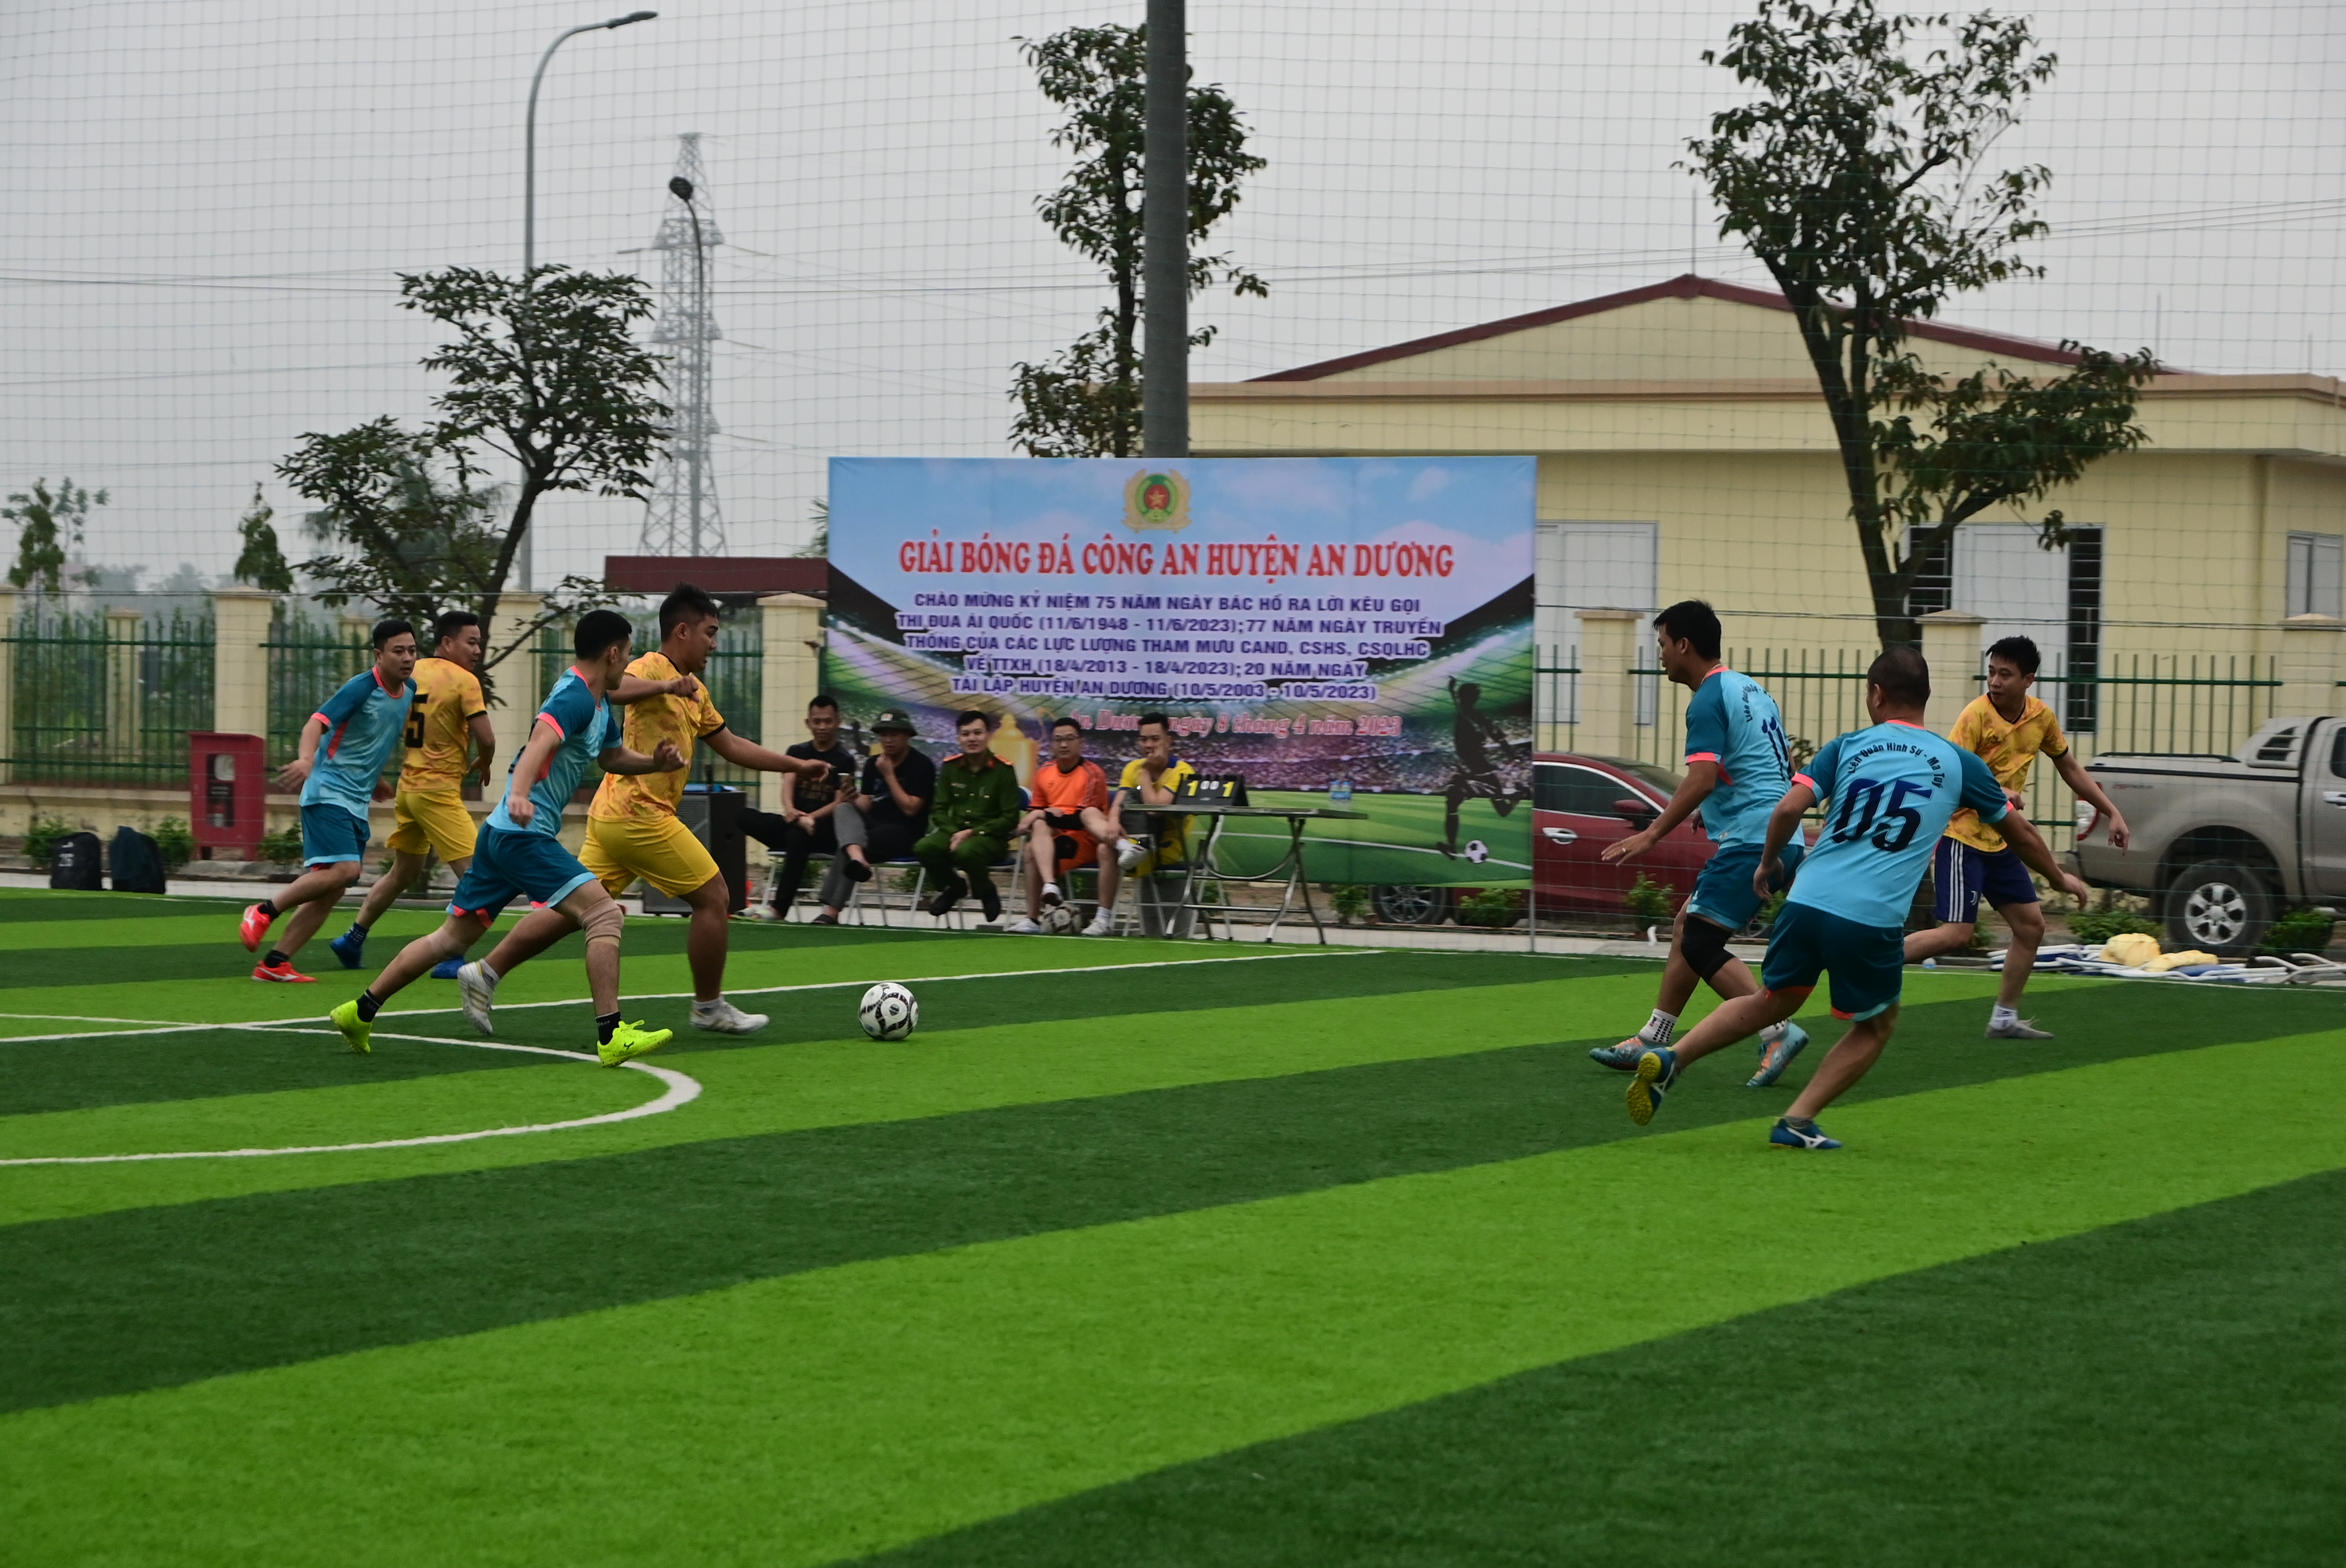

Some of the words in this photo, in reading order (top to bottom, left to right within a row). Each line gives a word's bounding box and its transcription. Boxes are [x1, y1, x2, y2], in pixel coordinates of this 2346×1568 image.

[900, 528, 955, 573] GIẢI
[960, 532, 1031, 574] BÓNG
[1038, 533, 1076, 574] ĐÁ
[1082, 533, 1155, 574] CÔNG
[1160, 542, 1200, 576] AN
[1206, 533, 1300, 584] HUYỆN
[1306, 543, 1348, 576] AN
[1353, 541, 1455, 577] DƯƠNG
[914, 590, 959, 607] CHÀO
[964, 590, 1014, 608] MỪNG
[1046, 593, 1090, 611] NIỆM
[1095, 596, 1116, 609] 75
[1121, 594, 1161, 610] NĂM
[1167, 594, 1213, 610] NGÀY
[1219, 595, 1253, 611] BÁC
[1289, 598, 1312, 612] RA
[1350, 596, 1384, 612] KÊU
[1391, 599, 1421, 615] GỌI
[898, 614, 922, 628] THI
[928, 615, 961, 629] ĐUA
[967, 612, 983, 628] ÁI
[988, 610, 1034, 629] QUỐC
[1039, 617, 1128, 631] (11/6/1948
[1273, 616, 1313, 633] NĂM
[1320, 617, 1367, 633] NGÀY
[967, 630, 999, 649] CỦA
[1006, 633, 1038, 650] CÁC
[1044, 637, 1075, 653] LỰC
[1081, 637, 1136, 654] LƯỢNG
[1143, 639, 1189, 653] THAM
[1196, 638, 1234, 653] MƯU
[1358, 642, 1428, 657] CSQLHC
[992, 657, 1032, 671] TTXH
[1038, 660, 1127, 675] (18/4/2013
[1271, 661, 1311, 676] NĂM
[1317, 661, 1365, 677] NGÀY
[952, 674, 977, 691] TÁI
[983, 675, 1014, 695] LẬP
[1020, 677, 1074, 696] HUYỆN
[1081, 681, 1103, 694] AN
[1110, 680, 1167, 695] DƯƠNG
[1174, 682, 1264, 698] (10/5/2003
[1284, 684, 1376, 700] 10/5/2023)
[1216, 713, 1229, 734] 8
[1292, 714, 1307, 735] 4
[1355, 715, 1402, 736] 2023
[1926, 756, 1941, 770] Ma
[1831, 778, 1934, 853] 05
